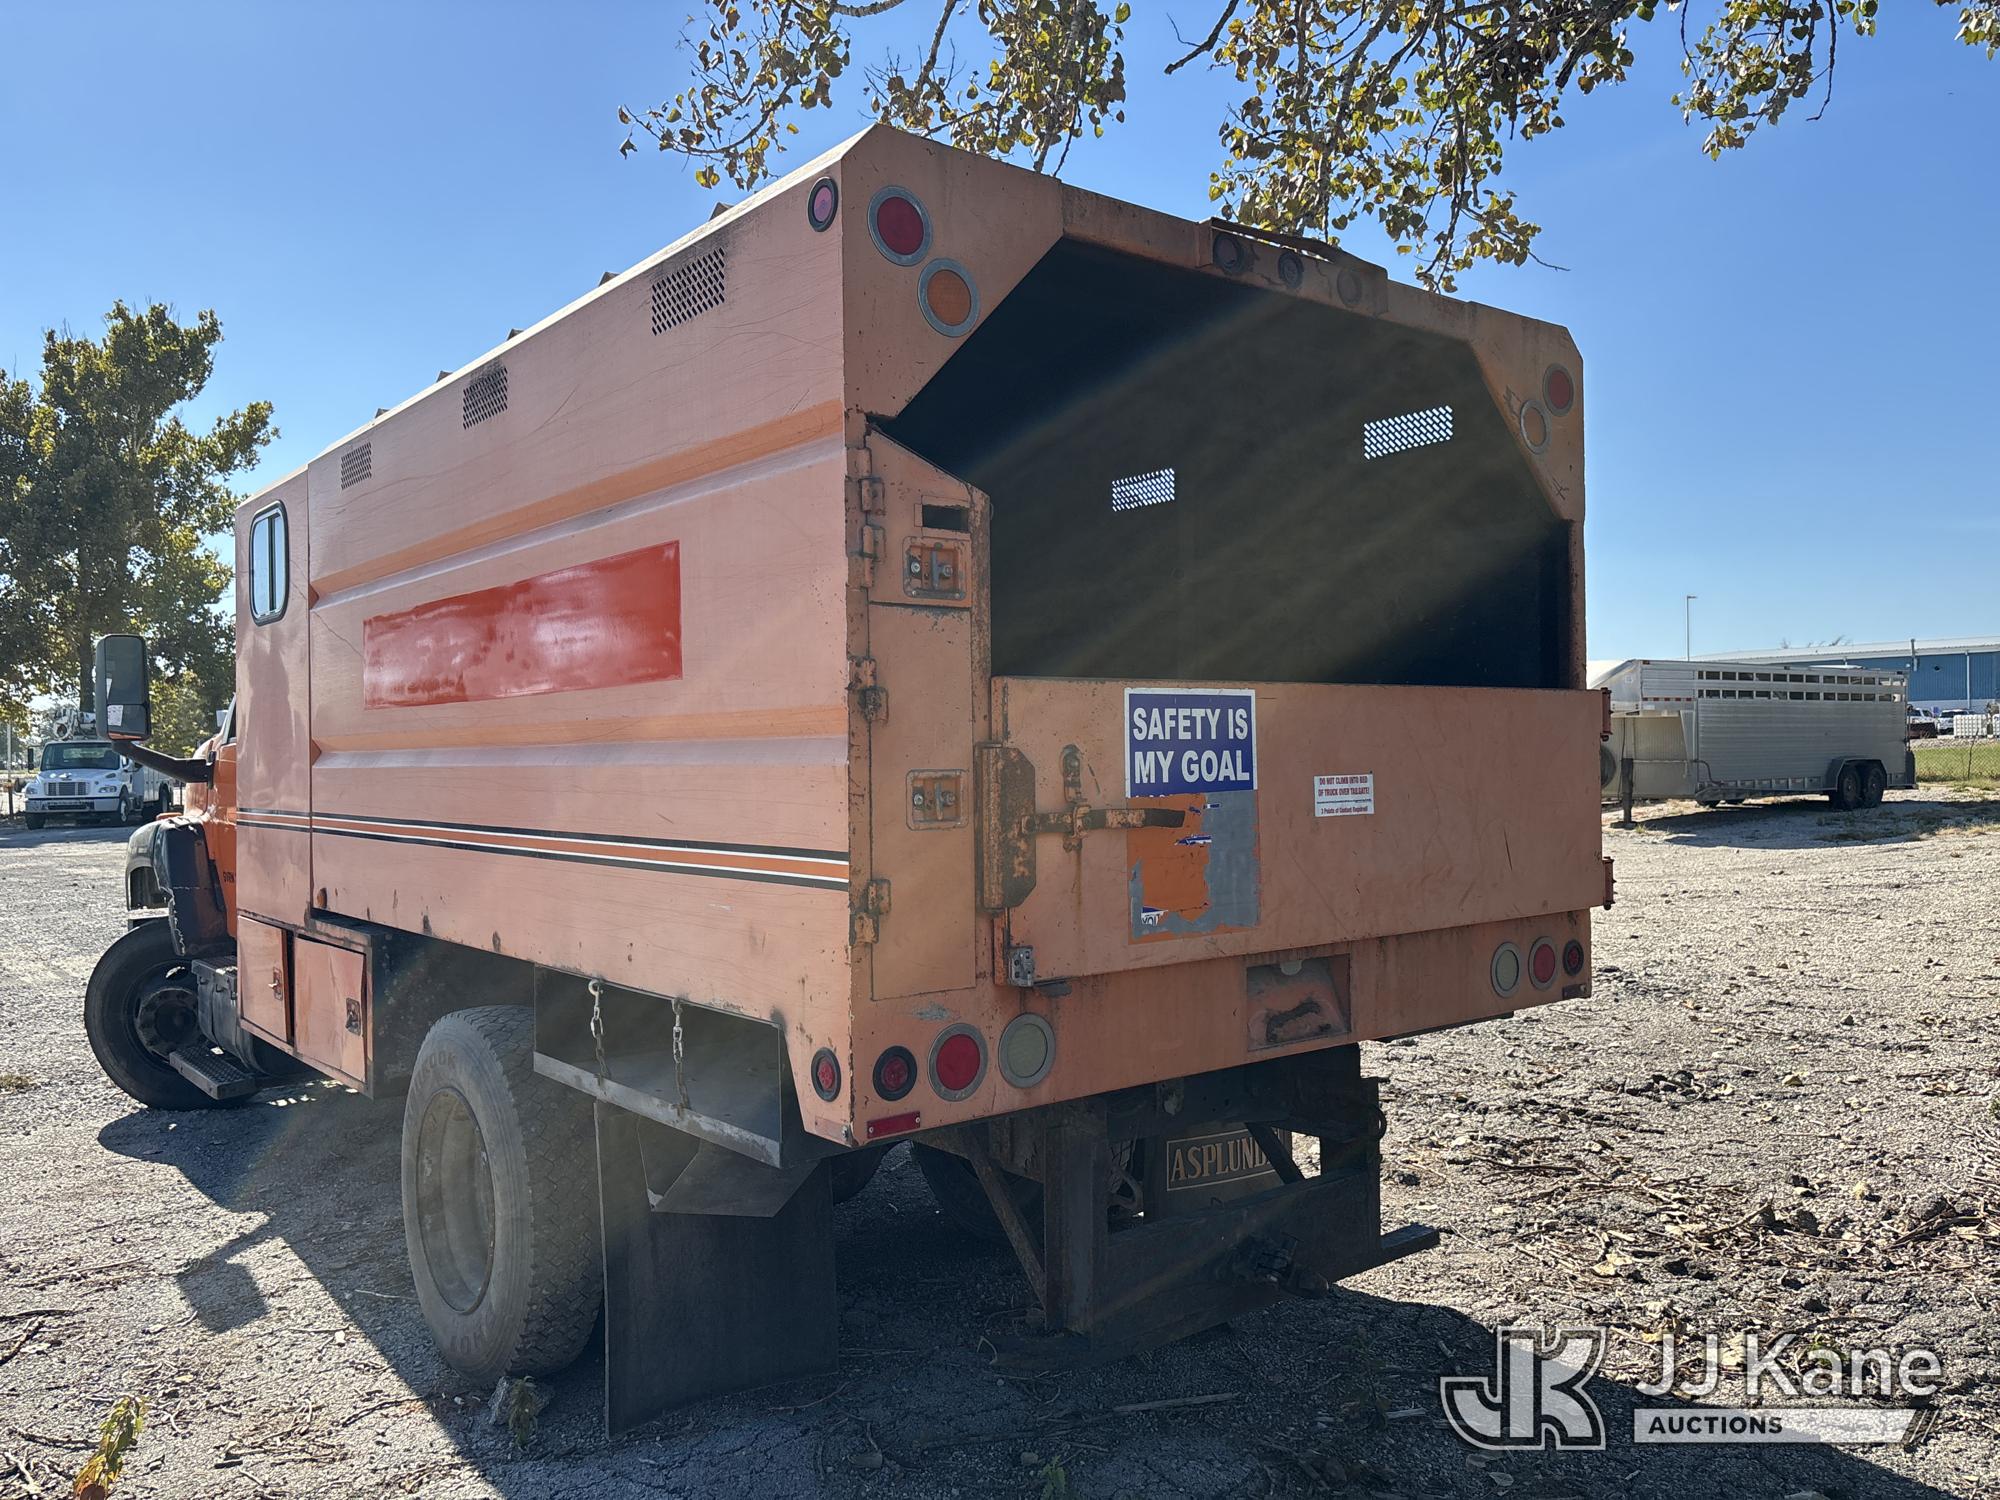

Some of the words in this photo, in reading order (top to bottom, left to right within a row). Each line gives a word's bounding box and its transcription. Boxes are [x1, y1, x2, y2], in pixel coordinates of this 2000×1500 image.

[1132, 707, 1221, 741] SAFETY
[1228, 708, 1248, 740] IS
[1134, 750, 1175, 784] MY
[1181, 749, 1250, 783] GOAL
[1319, 777, 1326, 786] DO
[1326, 777, 1335, 785] NOT
[1336, 776, 1349, 785] CLIMB
[1349, 776, 1359, 784] INTO
[1359, 775, 1368, 783] BED
[1318, 788, 1324, 797] OF
[1324, 788, 1338, 796] TRUCK
[1339, 787, 1350, 796] OVER
[1340, 806, 1352, 814] Contact
[1170, 1135, 1270, 1182] ASPLUND
